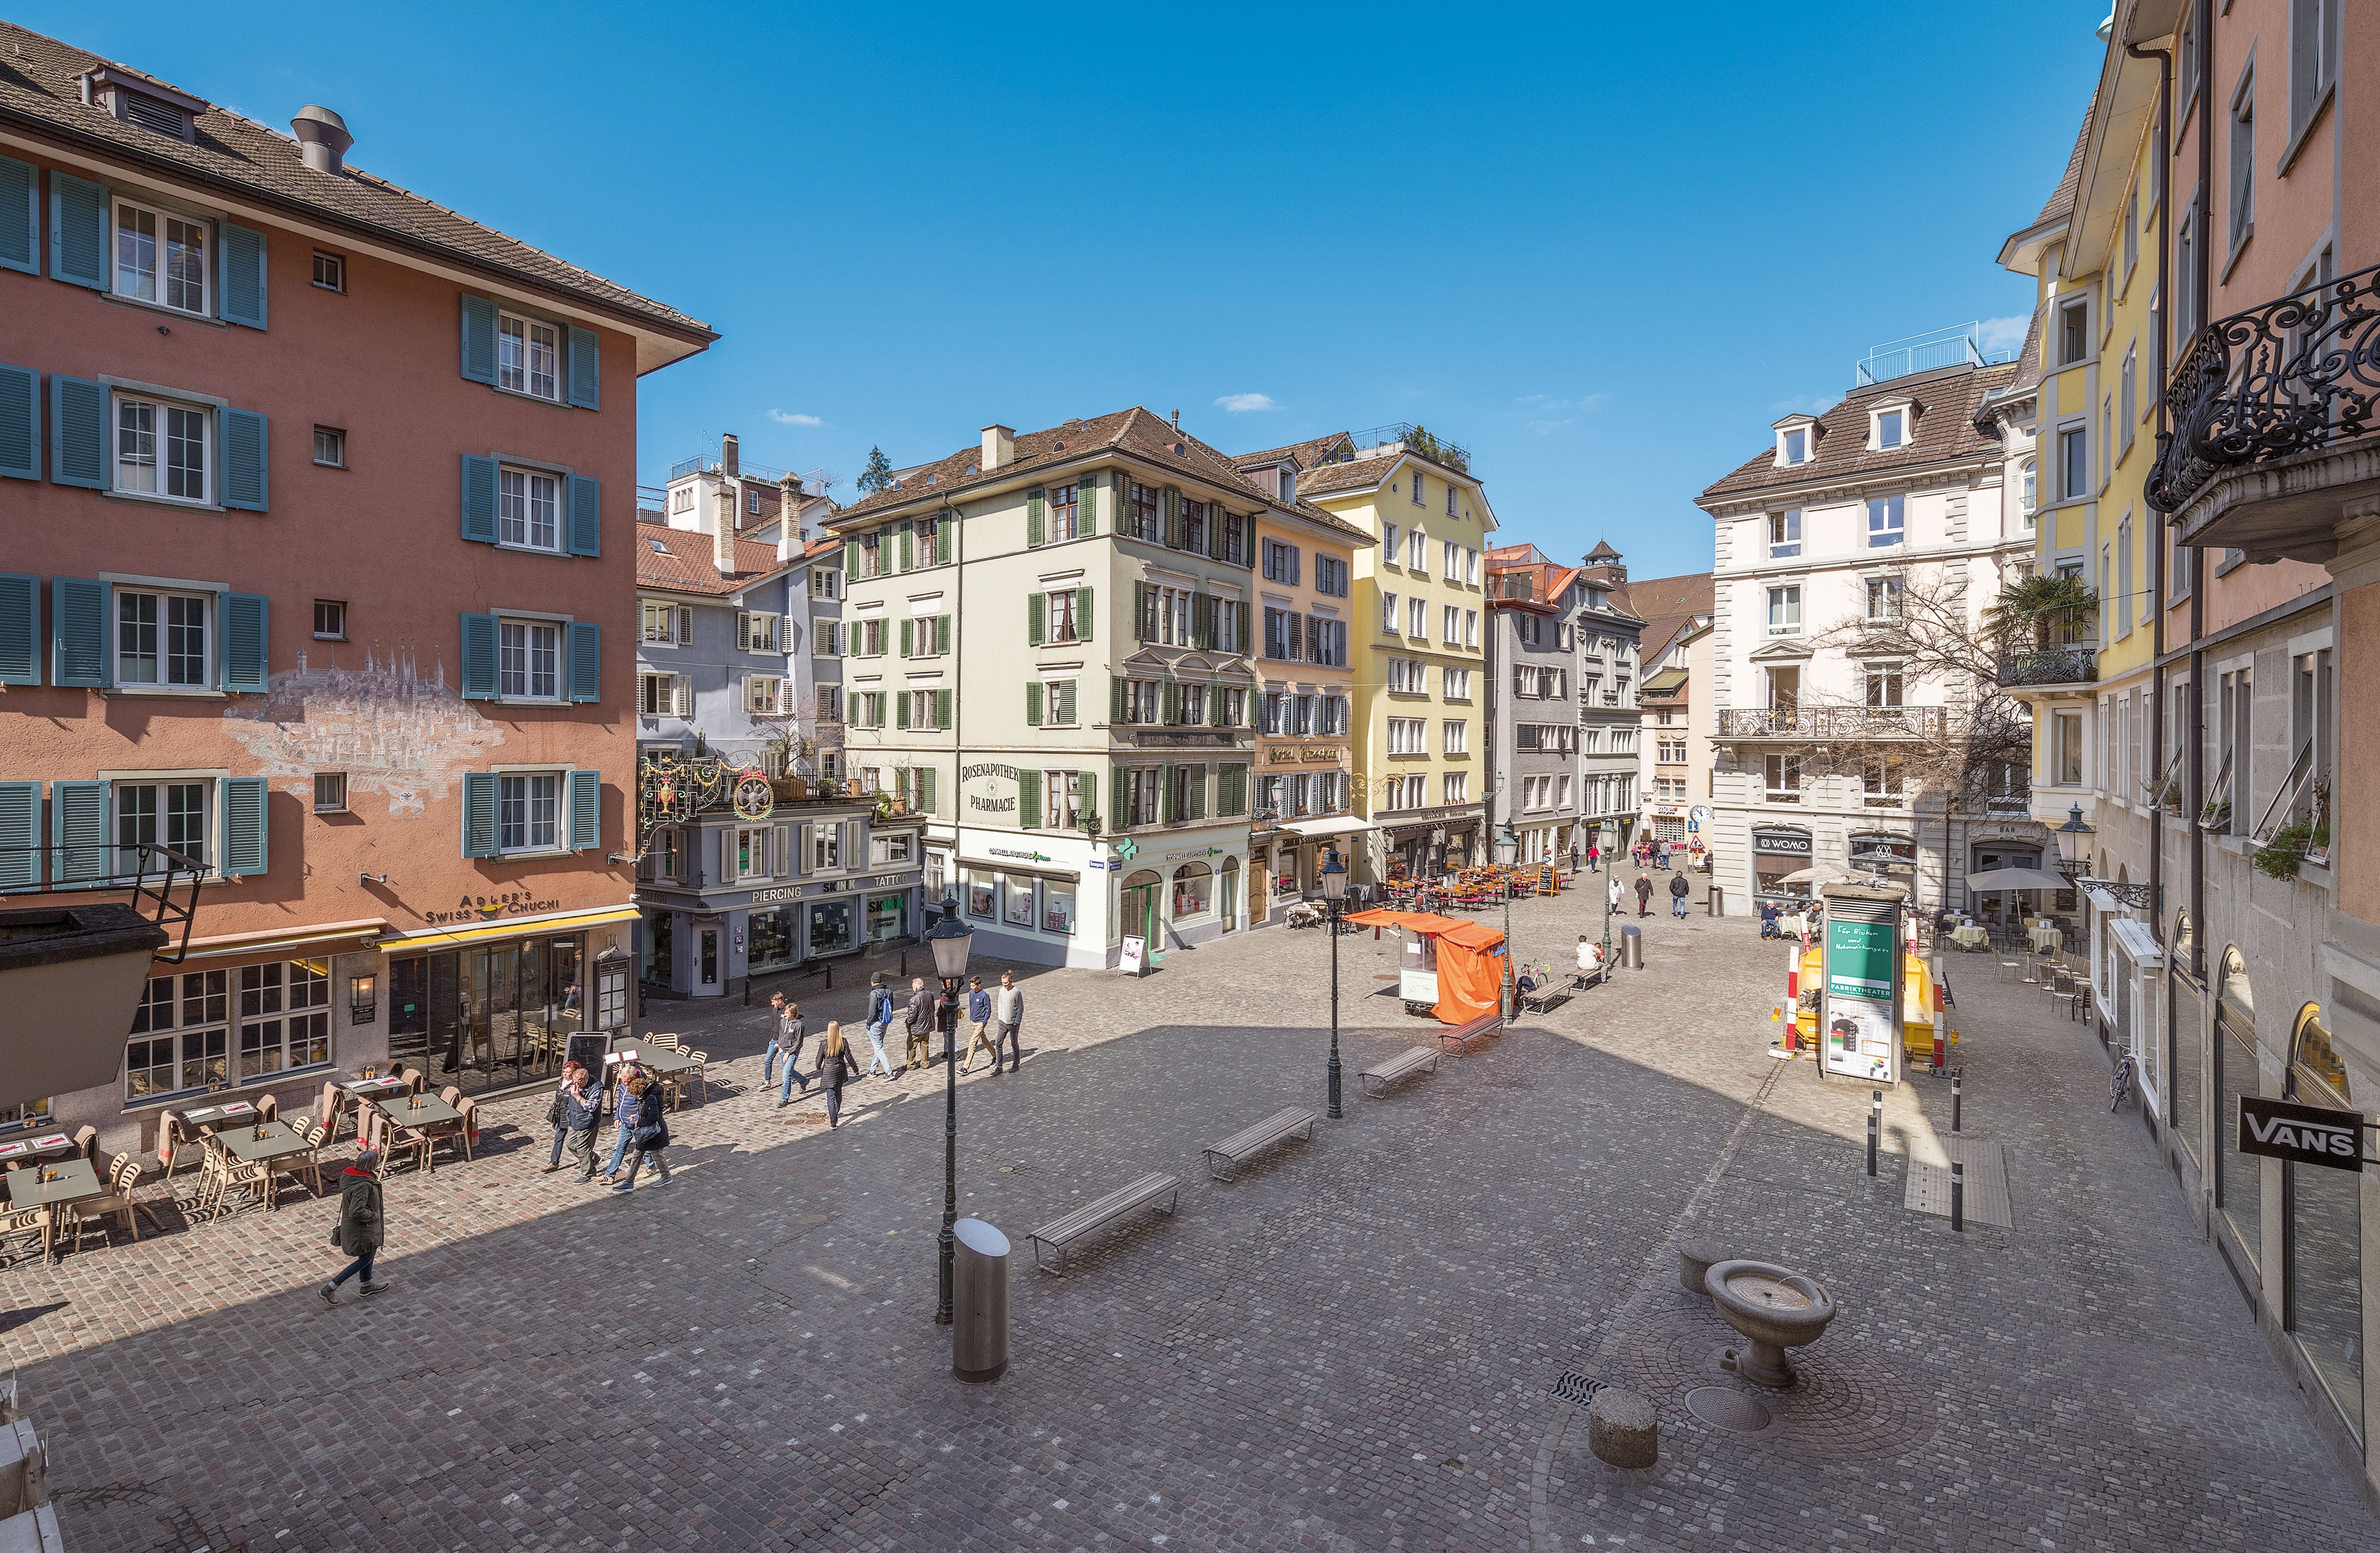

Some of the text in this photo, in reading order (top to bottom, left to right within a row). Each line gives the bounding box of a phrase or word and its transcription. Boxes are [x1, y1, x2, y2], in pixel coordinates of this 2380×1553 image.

[971, 794, 1015, 812] PHARMACIE
[1658, 806, 1676, 815] snipes
[1771, 839, 1808, 850] WOMO
[1167, 853, 1188, 862] TOPWELL
[874, 874, 907, 887] TATTOO
[460, 891, 532, 908] ADLER'S
[641, 890, 667, 904] TATTOO
[752, 886, 801, 903] PIERCING
[425, 900, 560, 924] SWISS CHUCHI
[1831, 984, 1891, 997] FABRIKTHEATER
[2244, 1112, 2355, 1157] VANS
